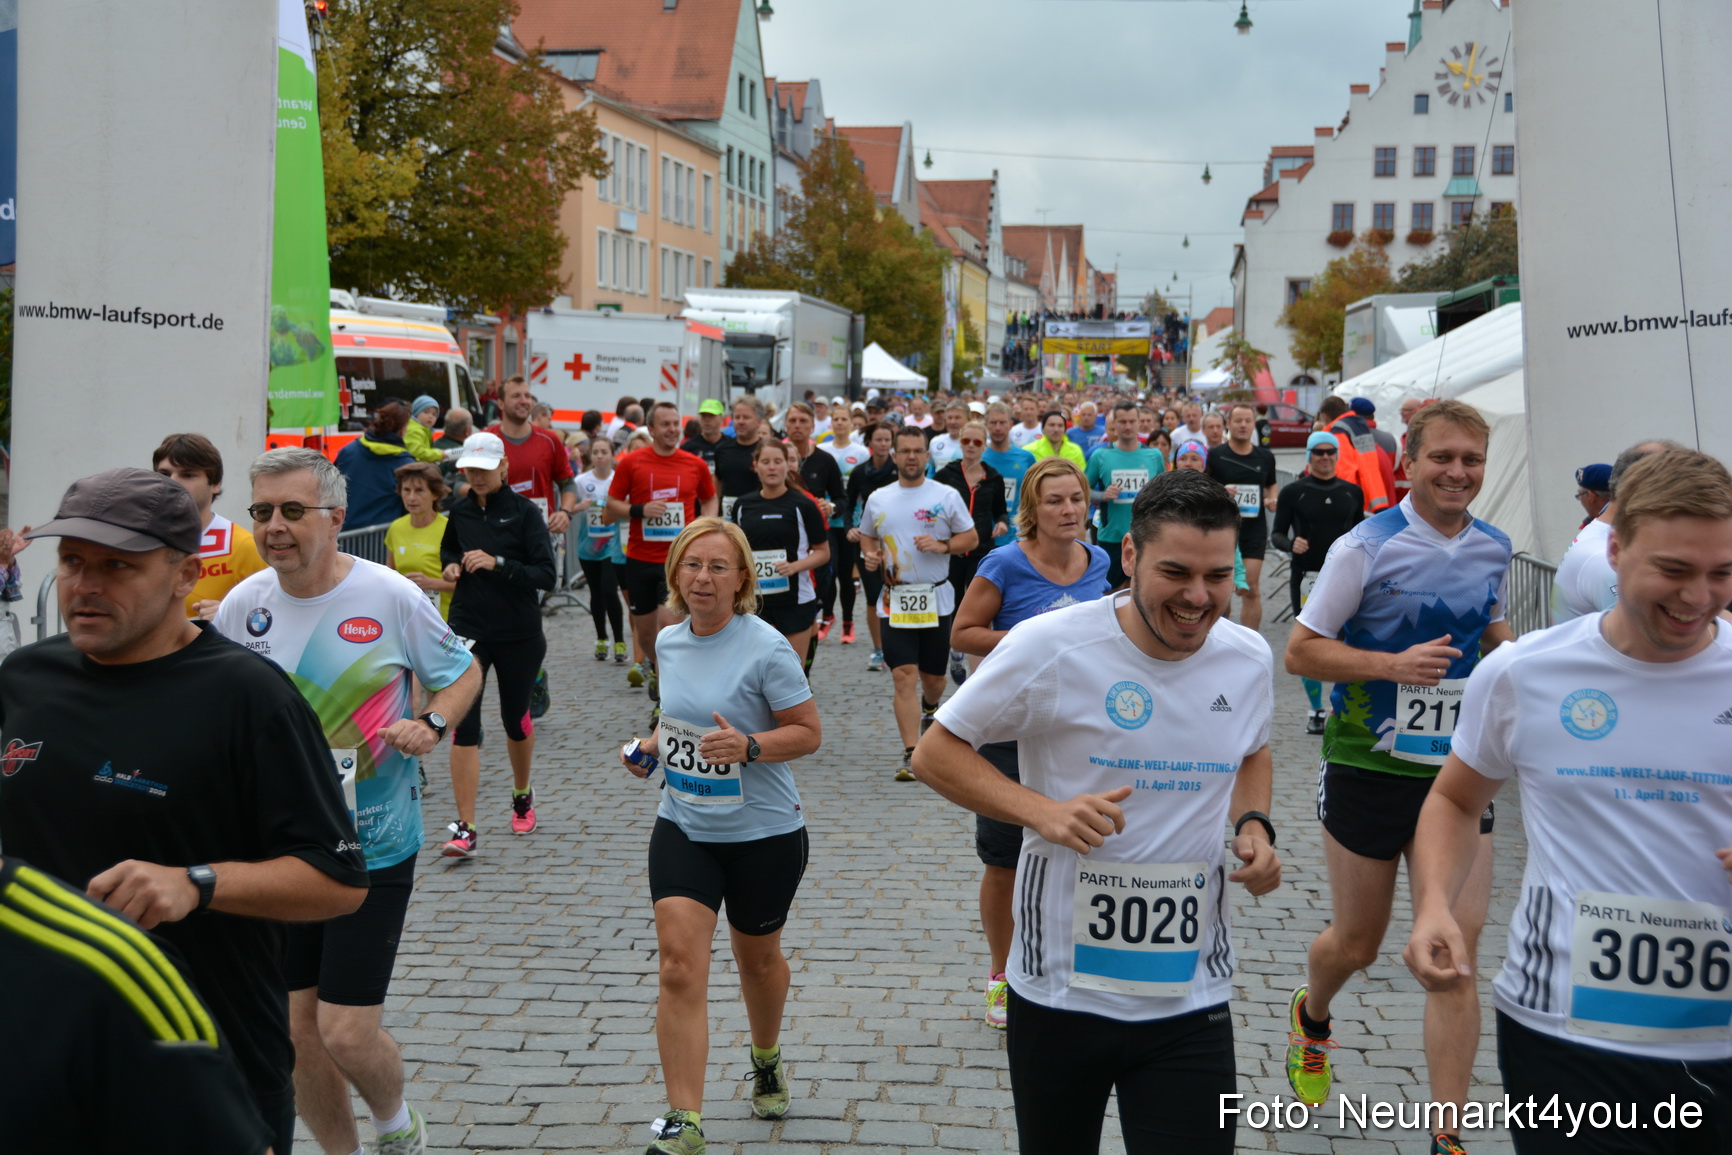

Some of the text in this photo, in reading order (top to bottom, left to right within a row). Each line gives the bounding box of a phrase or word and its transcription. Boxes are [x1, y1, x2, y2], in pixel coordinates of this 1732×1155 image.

[19, 302, 224, 331] www.bmw-laufsport.de
[1077, 342, 1112, 352] START
[596, 365, 619, 373] Rotes
[595, 375, 618, 383] Kreuz
[900, 595, 928, 612] 528
[344, 623, 378, 637] Hervis
[246, 641, 271, 650] PARTL
[1400, 685, 1433, 695] PARTL
[1210, 704, 1232, 712] adidas
[661, 722, 682, 735] PARTL
[1431, 740, 1452, 755] Sig
[682, 778, 711, 796] Helga
[1135, 779, 1201, 792] 11. April 2015
[1614, 788, 1700, 803] 11. April 2015
[357, 804, 384, 816] arkter
[1080, 872, 1191, 888] PARTL Neumarkt
[1089, 894, 1199, 944] 3028
[1580, 904, 1718, 931] PARTL Neumarkt
[1590, 928, 1731, 992] 3036
